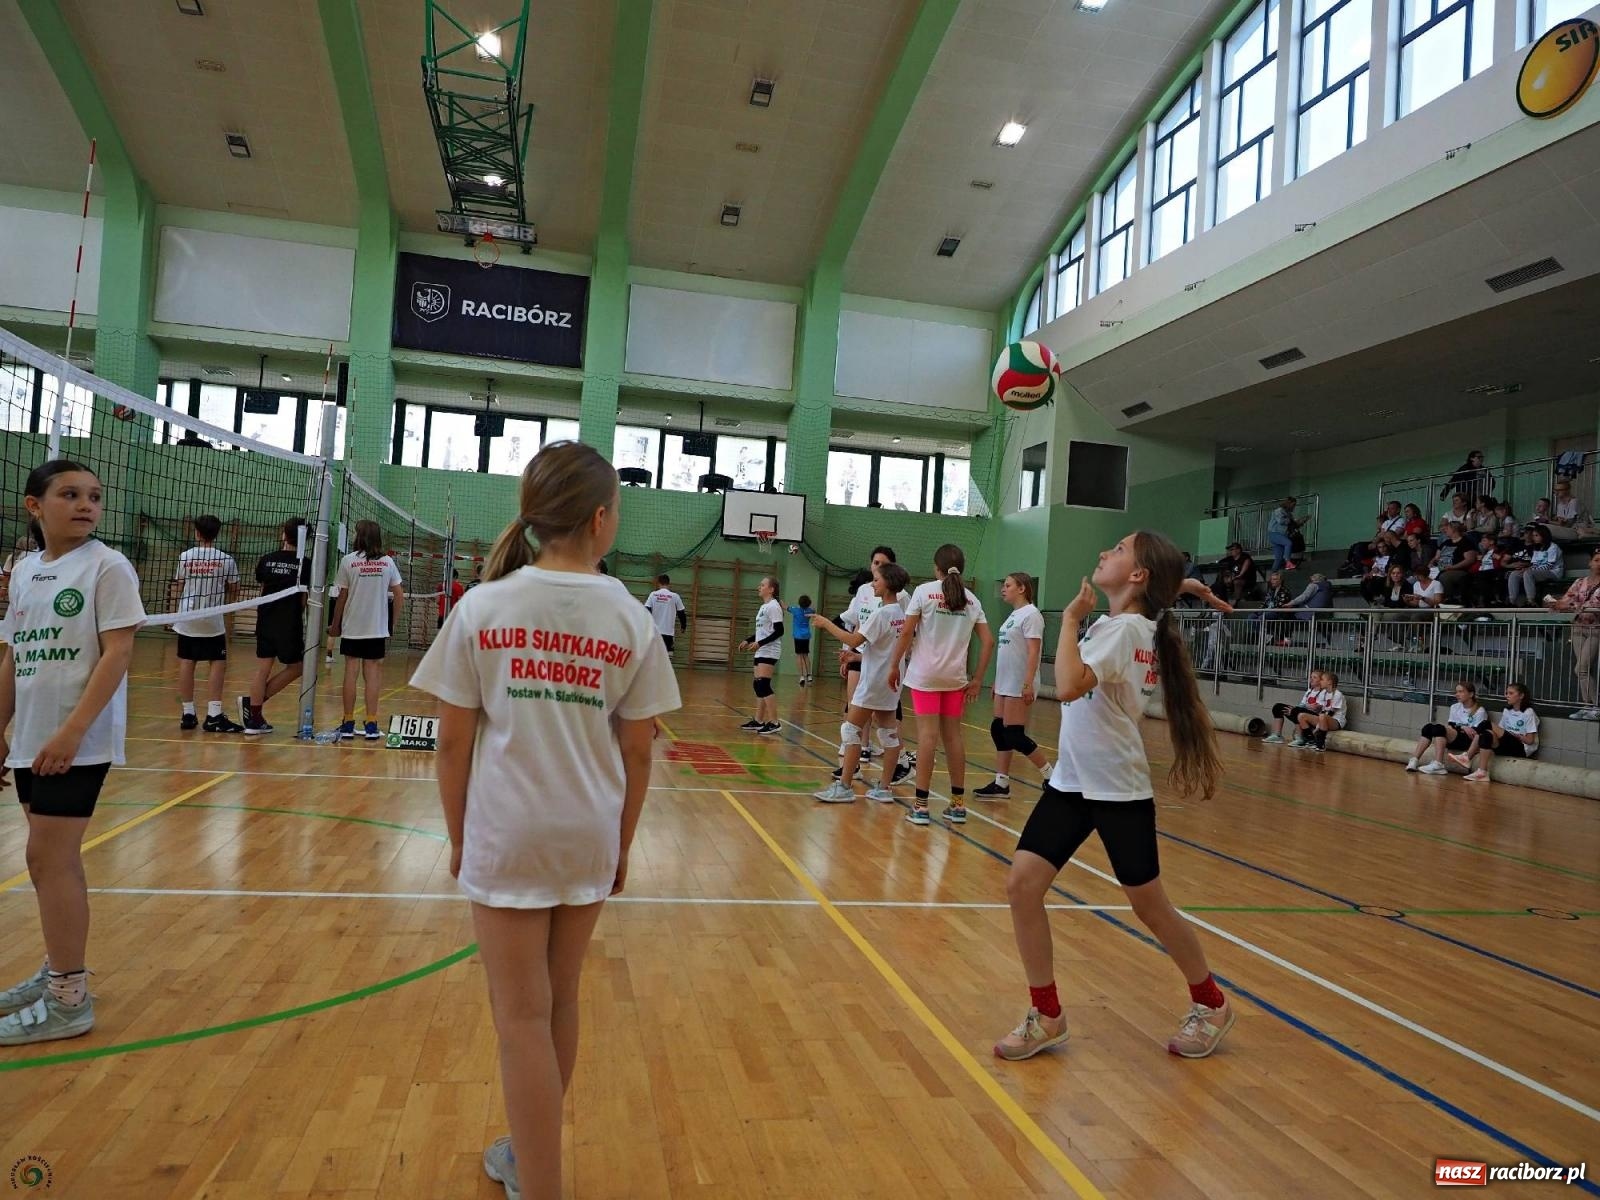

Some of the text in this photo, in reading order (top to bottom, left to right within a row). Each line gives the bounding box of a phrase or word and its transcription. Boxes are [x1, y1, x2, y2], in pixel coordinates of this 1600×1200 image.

[461, 299, 572, 328] RACIBÓRZ
[13, 626, 63, 645] GRAMY
[25, 648, 81, 663] MAMY
[479, 628, 632, 668] KLUB SIATKARSKI
[511, 658, 602, 689] RACIBÓRZ
[507, 686, 541, 699] Postaw
[404, 718, 434, 738] 15 8
[401, 739, 428, 747] MAKO
